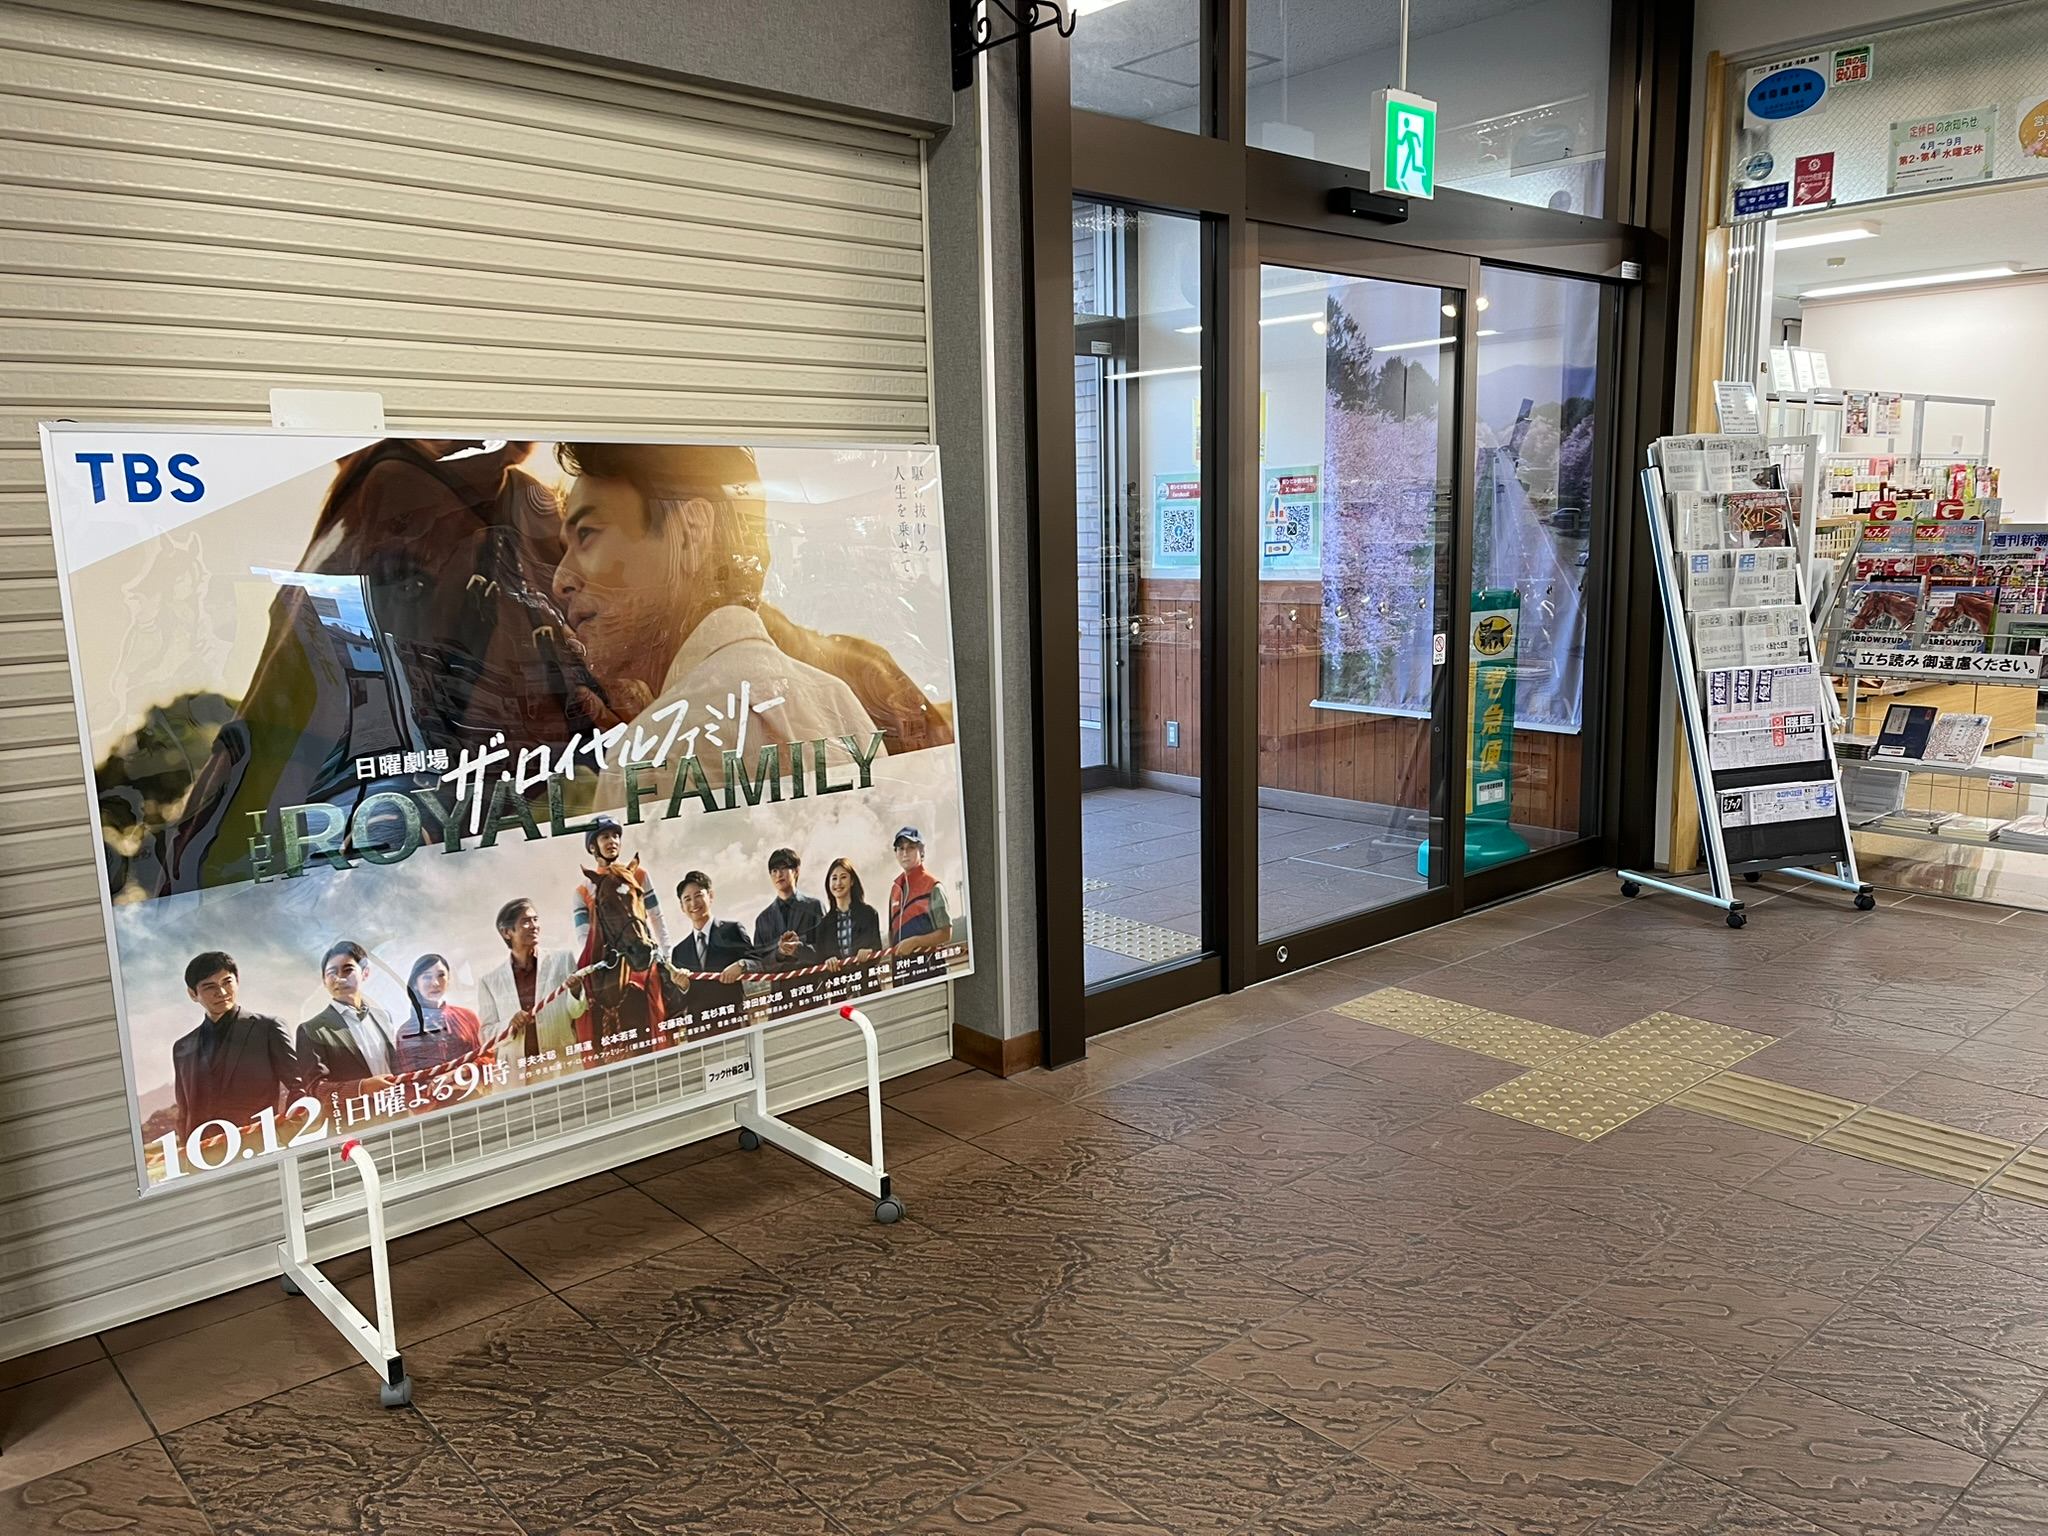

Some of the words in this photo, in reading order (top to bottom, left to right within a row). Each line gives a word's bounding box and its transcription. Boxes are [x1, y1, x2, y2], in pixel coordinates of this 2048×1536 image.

[1909, 115, 1979, 138] 定休日のお知らせ
[1942, 143, 1985, 160] 水曜定休
[75, 452, 205, 505] TBS
[893, 465, 912, 573] 人生を乗せて
[1993, 532, 2048, 548] 週刊新潮
[1859, 651, 1920, 668] 立ち読み
[1922, 654, 2036, 675] 御遠慮ください。
[355, 748, 449, 780] 日曜劇場
[441, 679, 786, 835] ザ・ロイヤルファミリー
[245, 809, 274, 885] THE
[279, 772, 601, 879] ROYAL
[622, 729, 888, 827] FAMILY
[850, 983, 862, 993] TBS
[600, 1028, 638, 1047] 松本若菜
[331, 1090, 343, 1136] start
[345, 1060, 510, 1128] 日曜よる9時
[151, 1095, 329, 1184] 10.12
